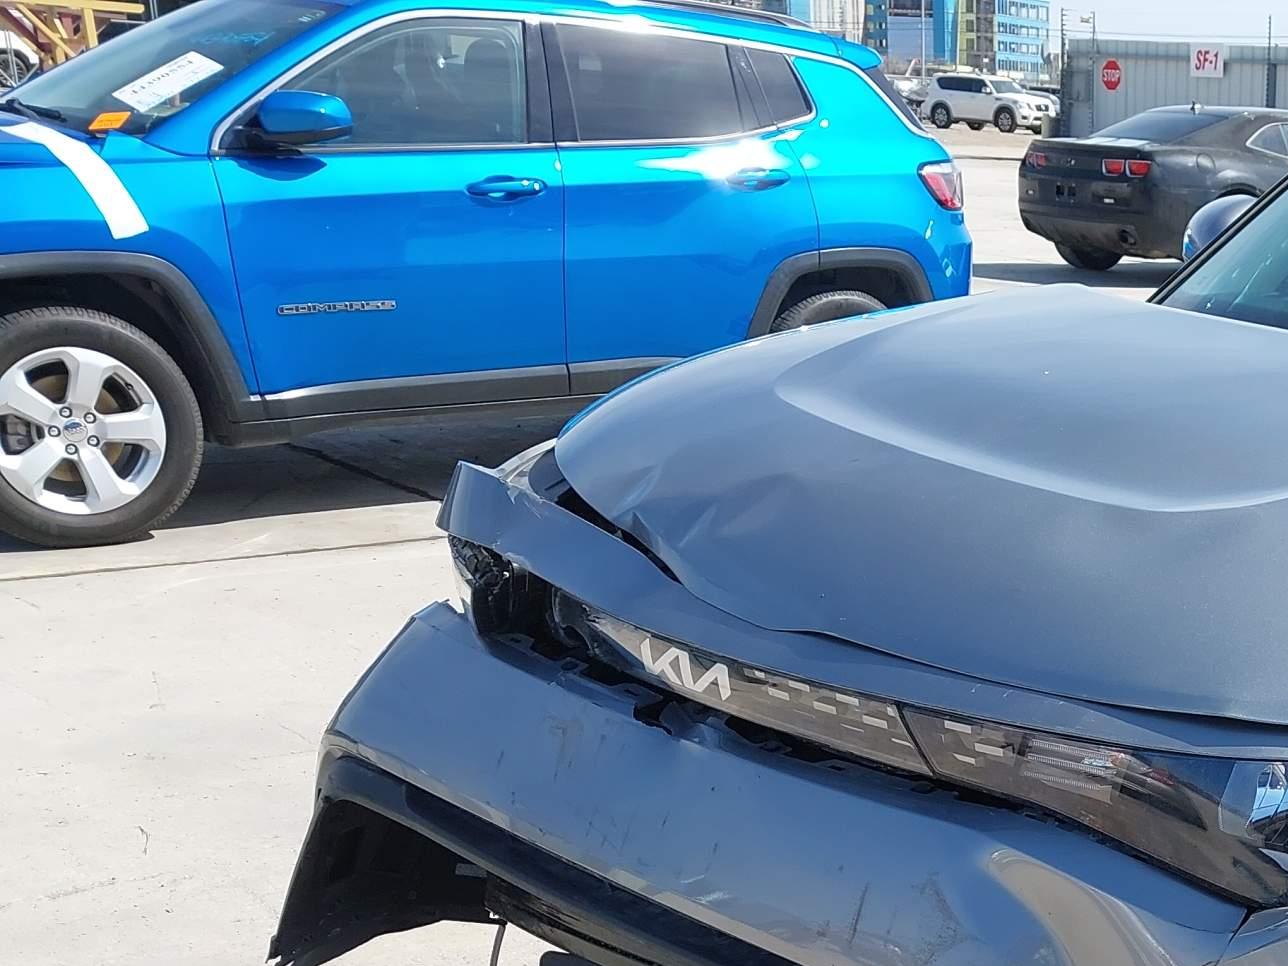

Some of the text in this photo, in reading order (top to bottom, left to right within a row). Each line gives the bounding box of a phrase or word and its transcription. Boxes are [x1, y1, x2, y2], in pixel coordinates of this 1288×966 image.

[1195, 49, 1219, 71] SF-1
[1103, 69, 1120, 81] STOP
[278, 299, 397, 315] COMPASS
[640, 638, 731, 701] KIA
